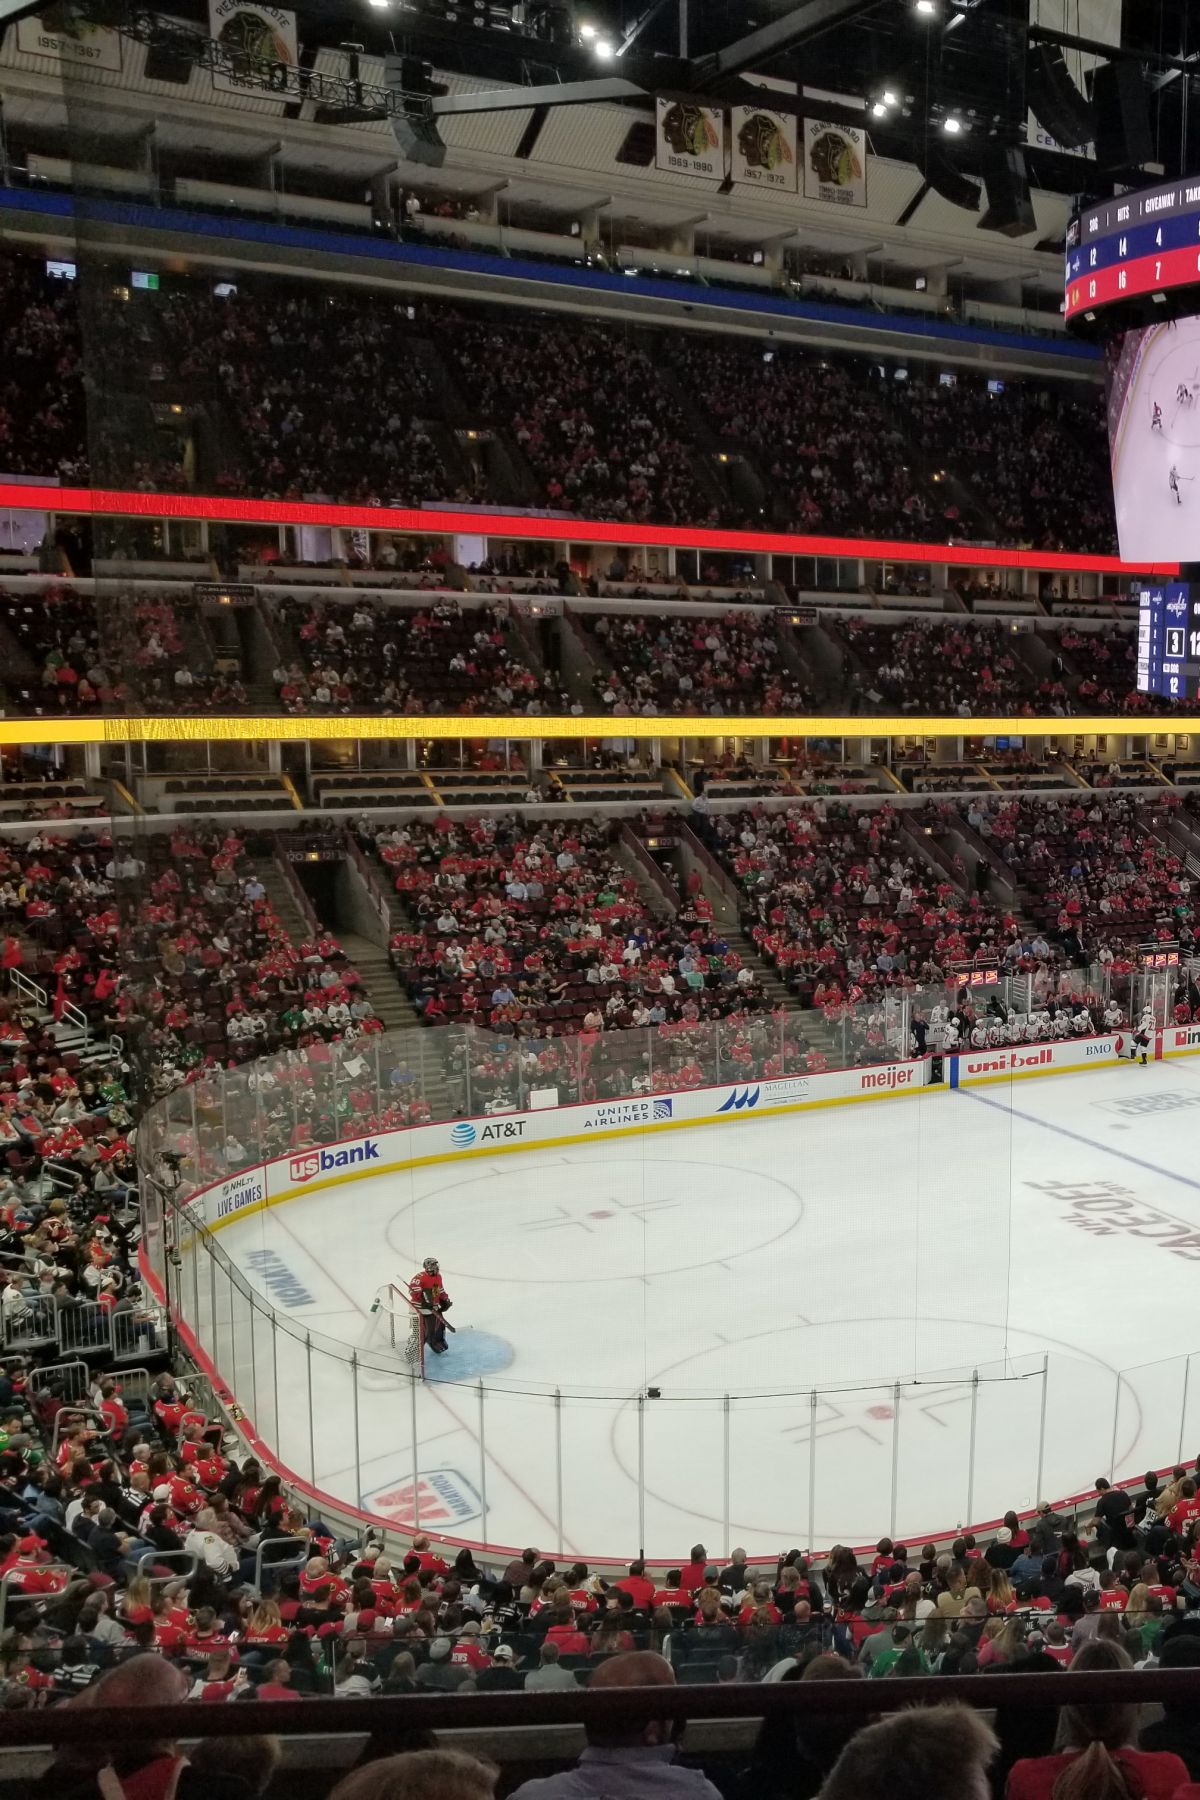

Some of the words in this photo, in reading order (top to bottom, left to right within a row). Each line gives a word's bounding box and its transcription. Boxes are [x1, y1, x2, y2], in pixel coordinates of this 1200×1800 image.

[1117, 205, 1130, 222] HITS
[1145, 191, 1176, 213] GIVEAWAY
[1090, 247, 1097, 266] 12
[1118, 237, 1127, 257] 14
[1118, 270, 1127, 289] 16
[1170, 677, 1178, 693] 12
[1085, 1043, 1112, 1056] BMO
[967, 1049, 1052, 1073] uni-ball
[765, 1080, 809, 1091] MAGELLAN
[861, 1067, 914, 1088] meijer
[597, 1103, 649, 1117] UNITED
[584, 1112, 649, 1128] AIRLINES
[481, 1121, 526, 1140] AT&T
[218, 1198, 233, 1217] LIVE
[234, 1185, 261, 1209] GAMES
[1060, 1212, 1120, 1236] NHL
[429, 1475, 475, 1515] MARATHON
[1106, 1601, 1123, 1609] KANE
